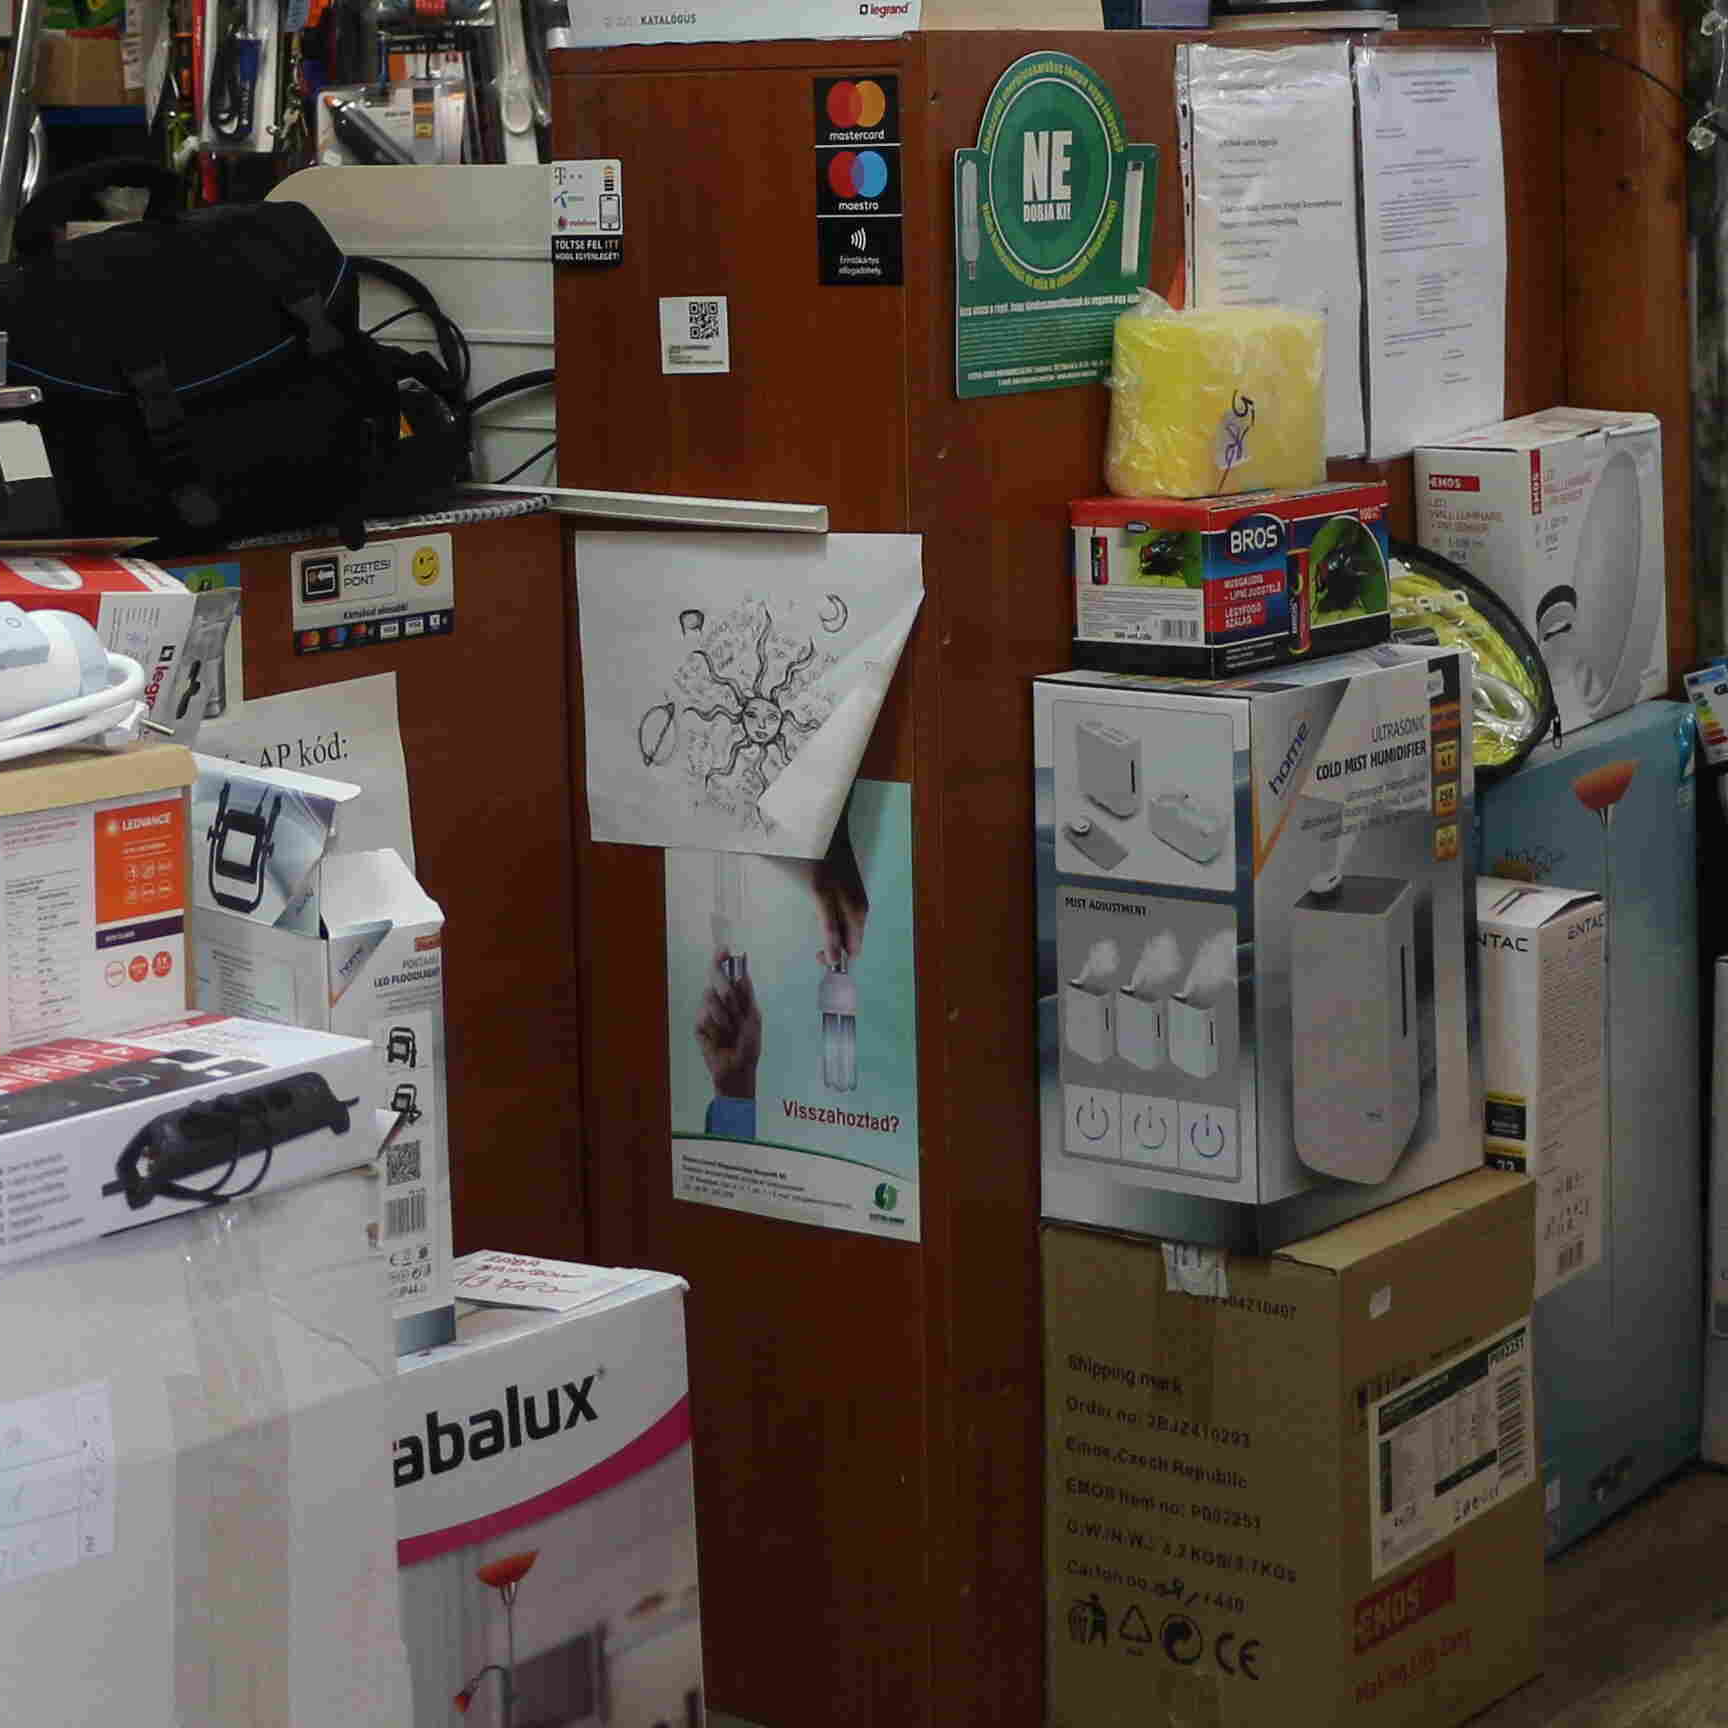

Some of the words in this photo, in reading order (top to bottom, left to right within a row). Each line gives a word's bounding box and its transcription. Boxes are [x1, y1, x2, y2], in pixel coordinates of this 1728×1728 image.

[871, 3, 910, 19] legrand
[829, 129, 885, 142] mastercard
[1023, 130, 1073, 203] NE
[838, 201, 880, 213] maestro
[1230, 525, 1280, 555] BROS
[343, 573, 377, 590] PONT
[1371, 713, 1426, 745] ULTRASONIC
[260, 745, 292, 769] AP
[297, 734, 349, 765] kód:
[1268, 720, 1311, 797] home
[1316, 761, 1342, 783] COLD
[1343, 753, 1369, 775] MIST
[1370, 739, 1428, 768] HUMIDIFIER
[1064, 896, 1086, 910] MIST
[1088, 899, 1147, 917] ADJUSTMENT
[782, 1097, 902, 1135] Visszahoztad?
[1067, 1352, 1136, 1389] Shipping
[1065, 1396, 1110, 1420] Order
[1173, 1461, 1249, 1491] Republic
